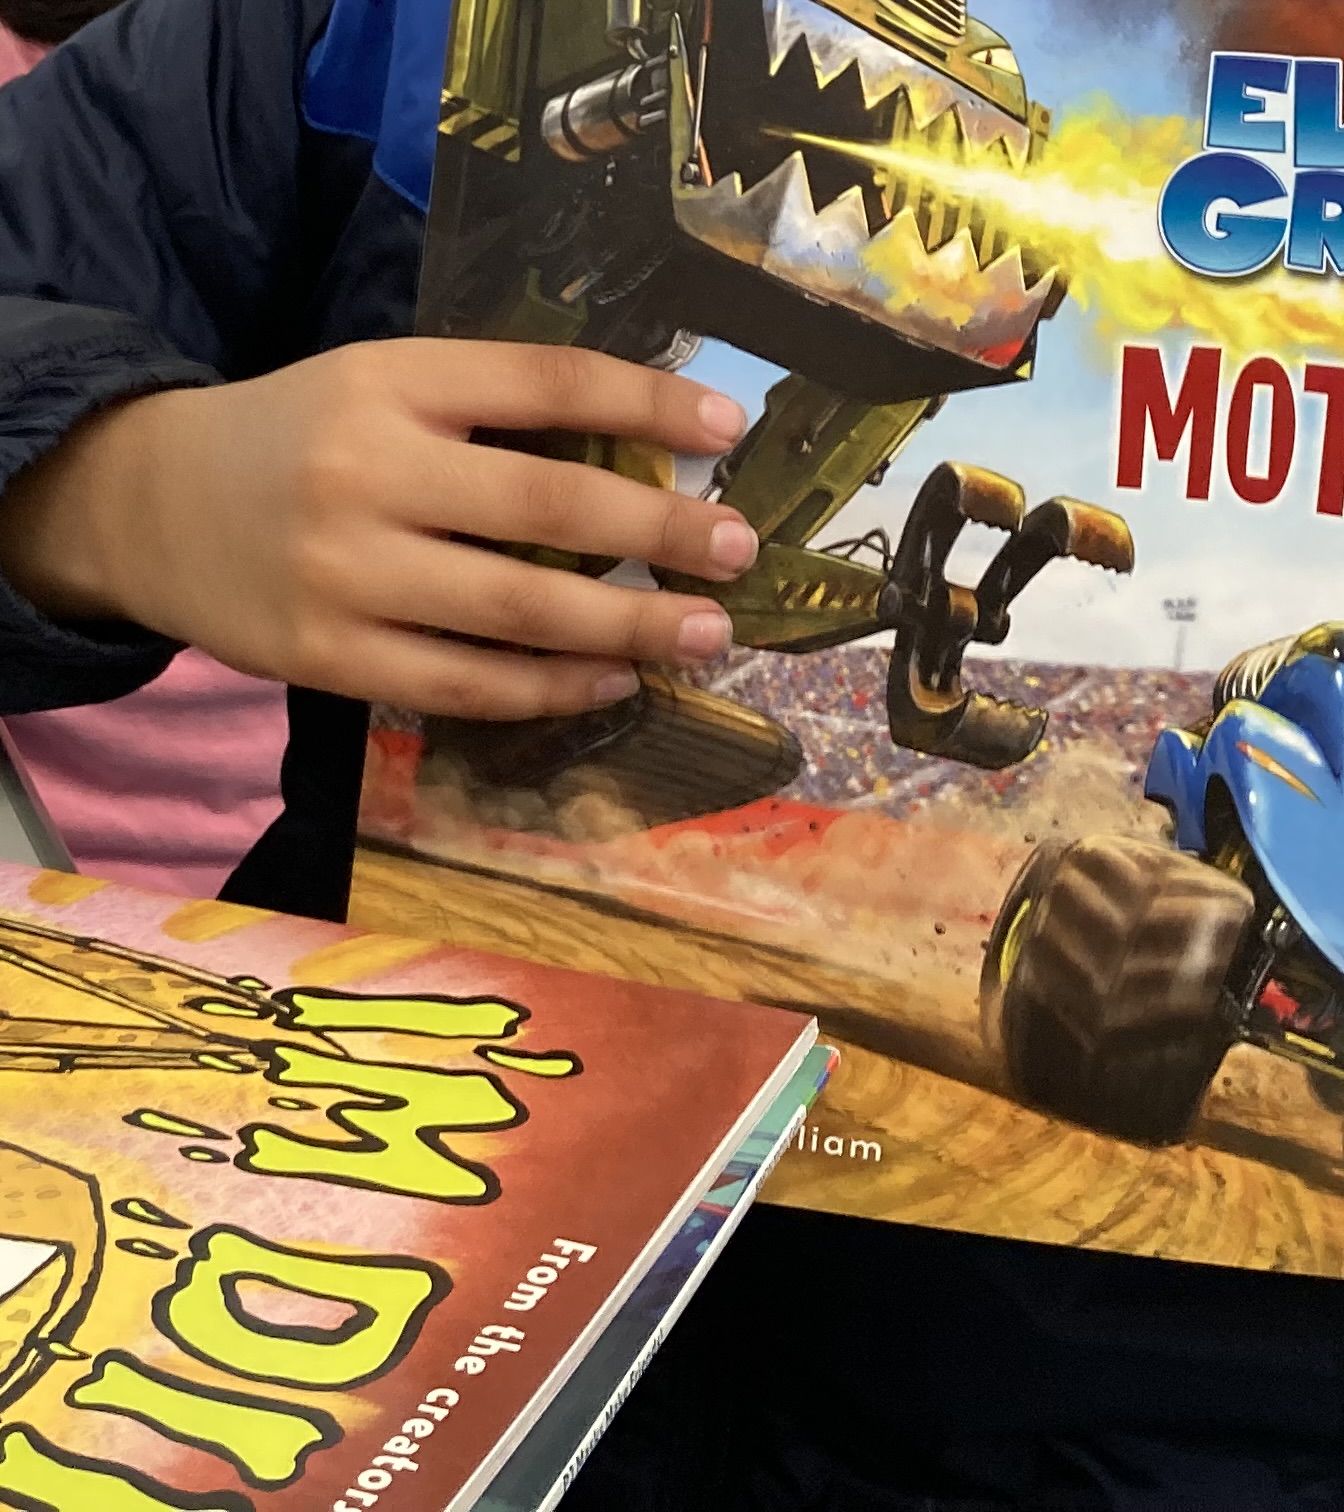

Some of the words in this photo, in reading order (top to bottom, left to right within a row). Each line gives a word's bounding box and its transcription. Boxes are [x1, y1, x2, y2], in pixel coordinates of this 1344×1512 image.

[789, 1124, 883, 1163] liam
[503, 1236, 598, 1314] From
[454, 1325, 525, 1378] the
